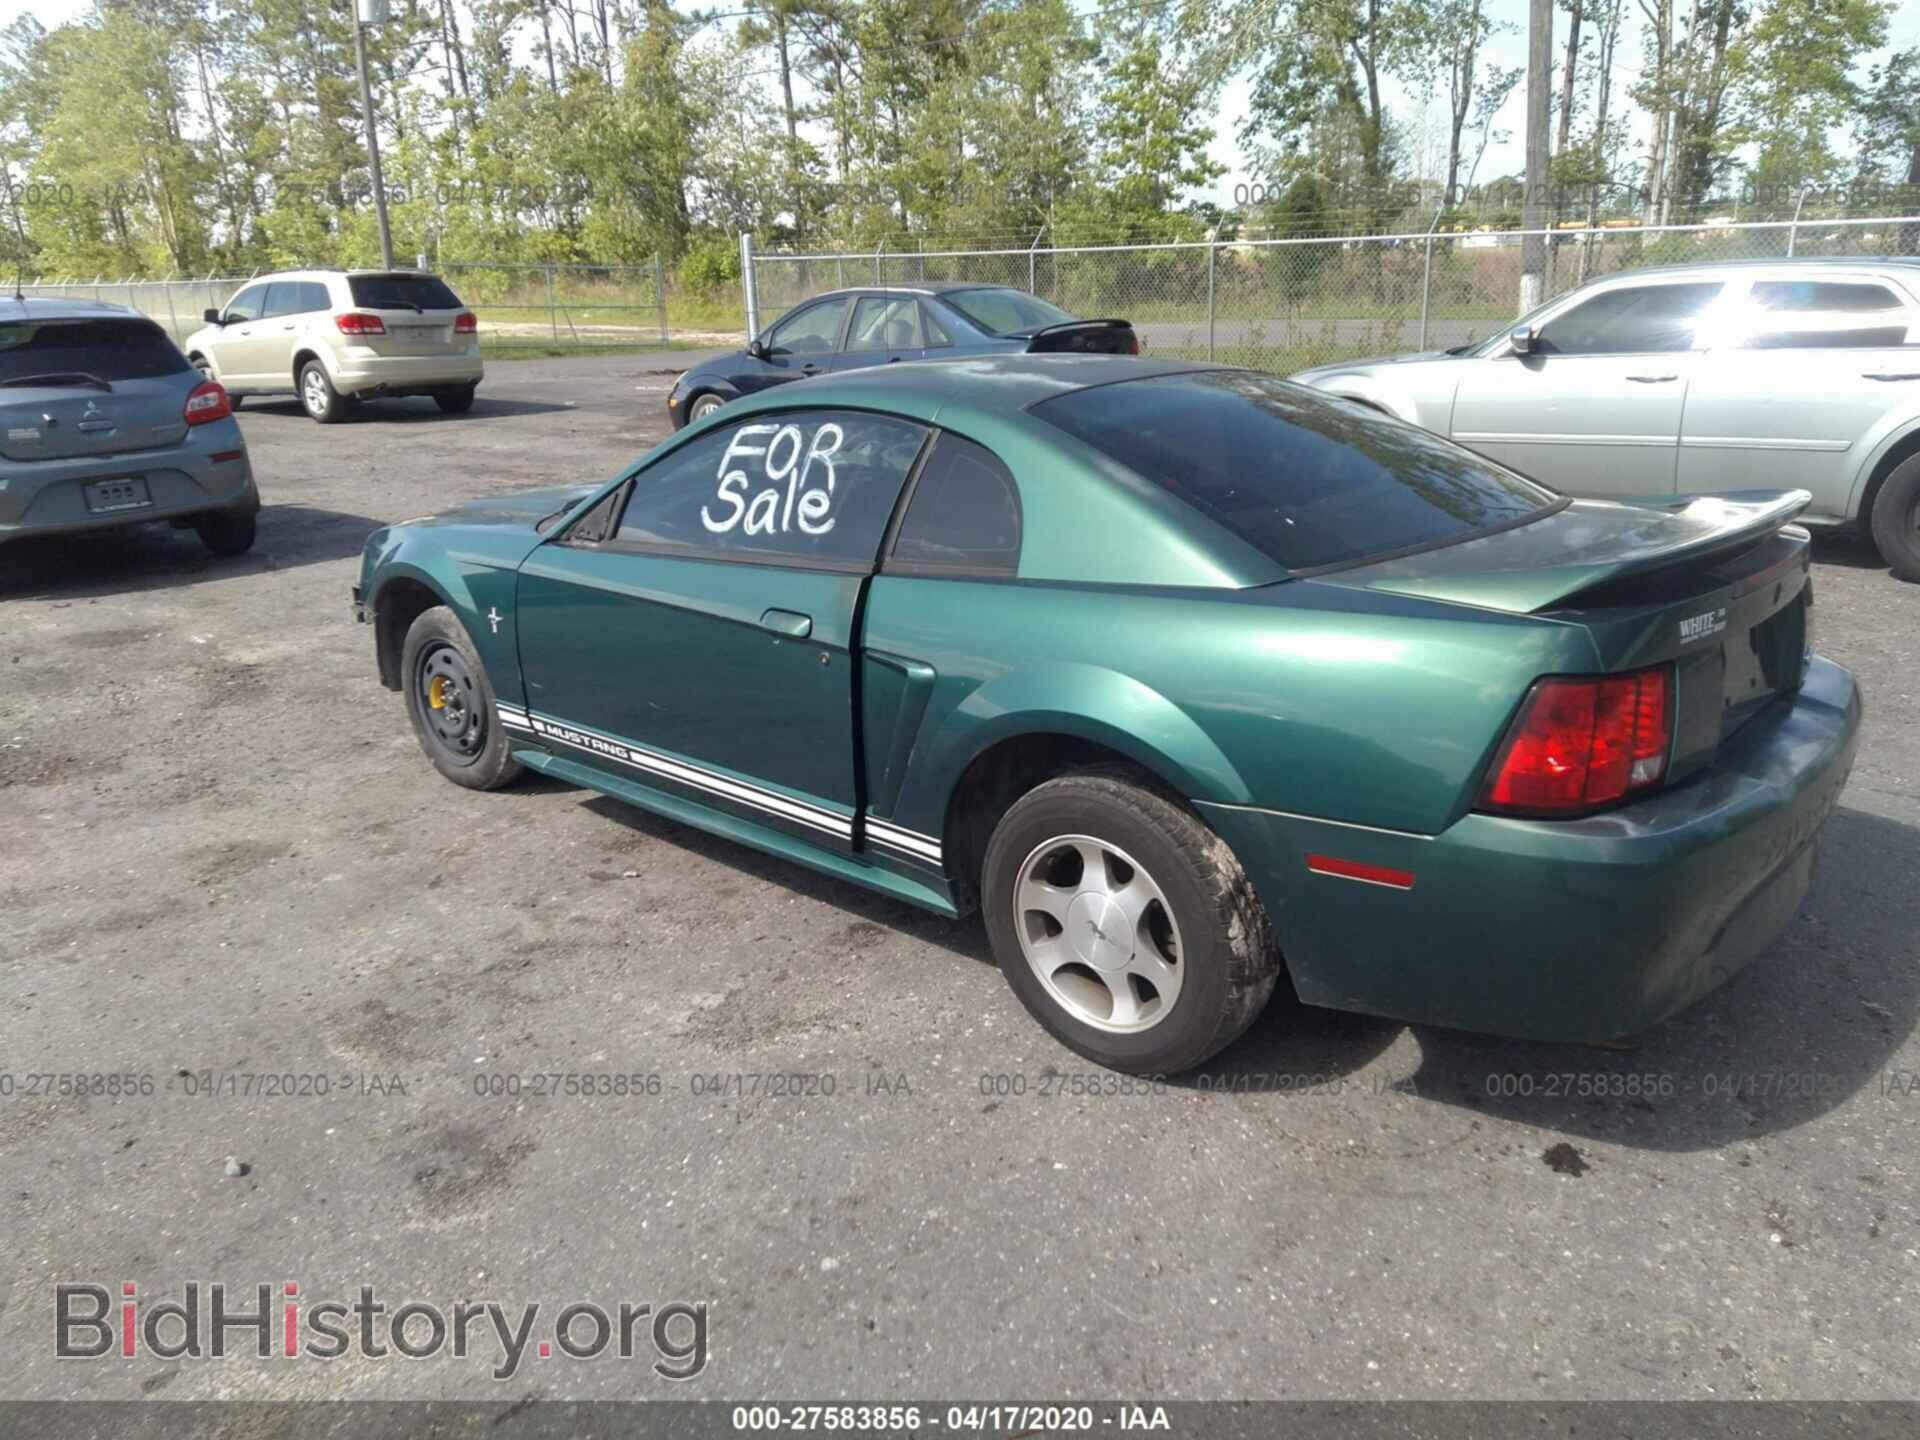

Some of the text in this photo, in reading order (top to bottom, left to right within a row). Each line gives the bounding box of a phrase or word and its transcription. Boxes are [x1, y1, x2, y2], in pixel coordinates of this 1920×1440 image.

[717, 423, 843, 495] FOR
[701, 467, 836, 535] Sale
[1680, 611, 1715, 636] WHITE
[546, 725, 630, 758] MUSTANG
